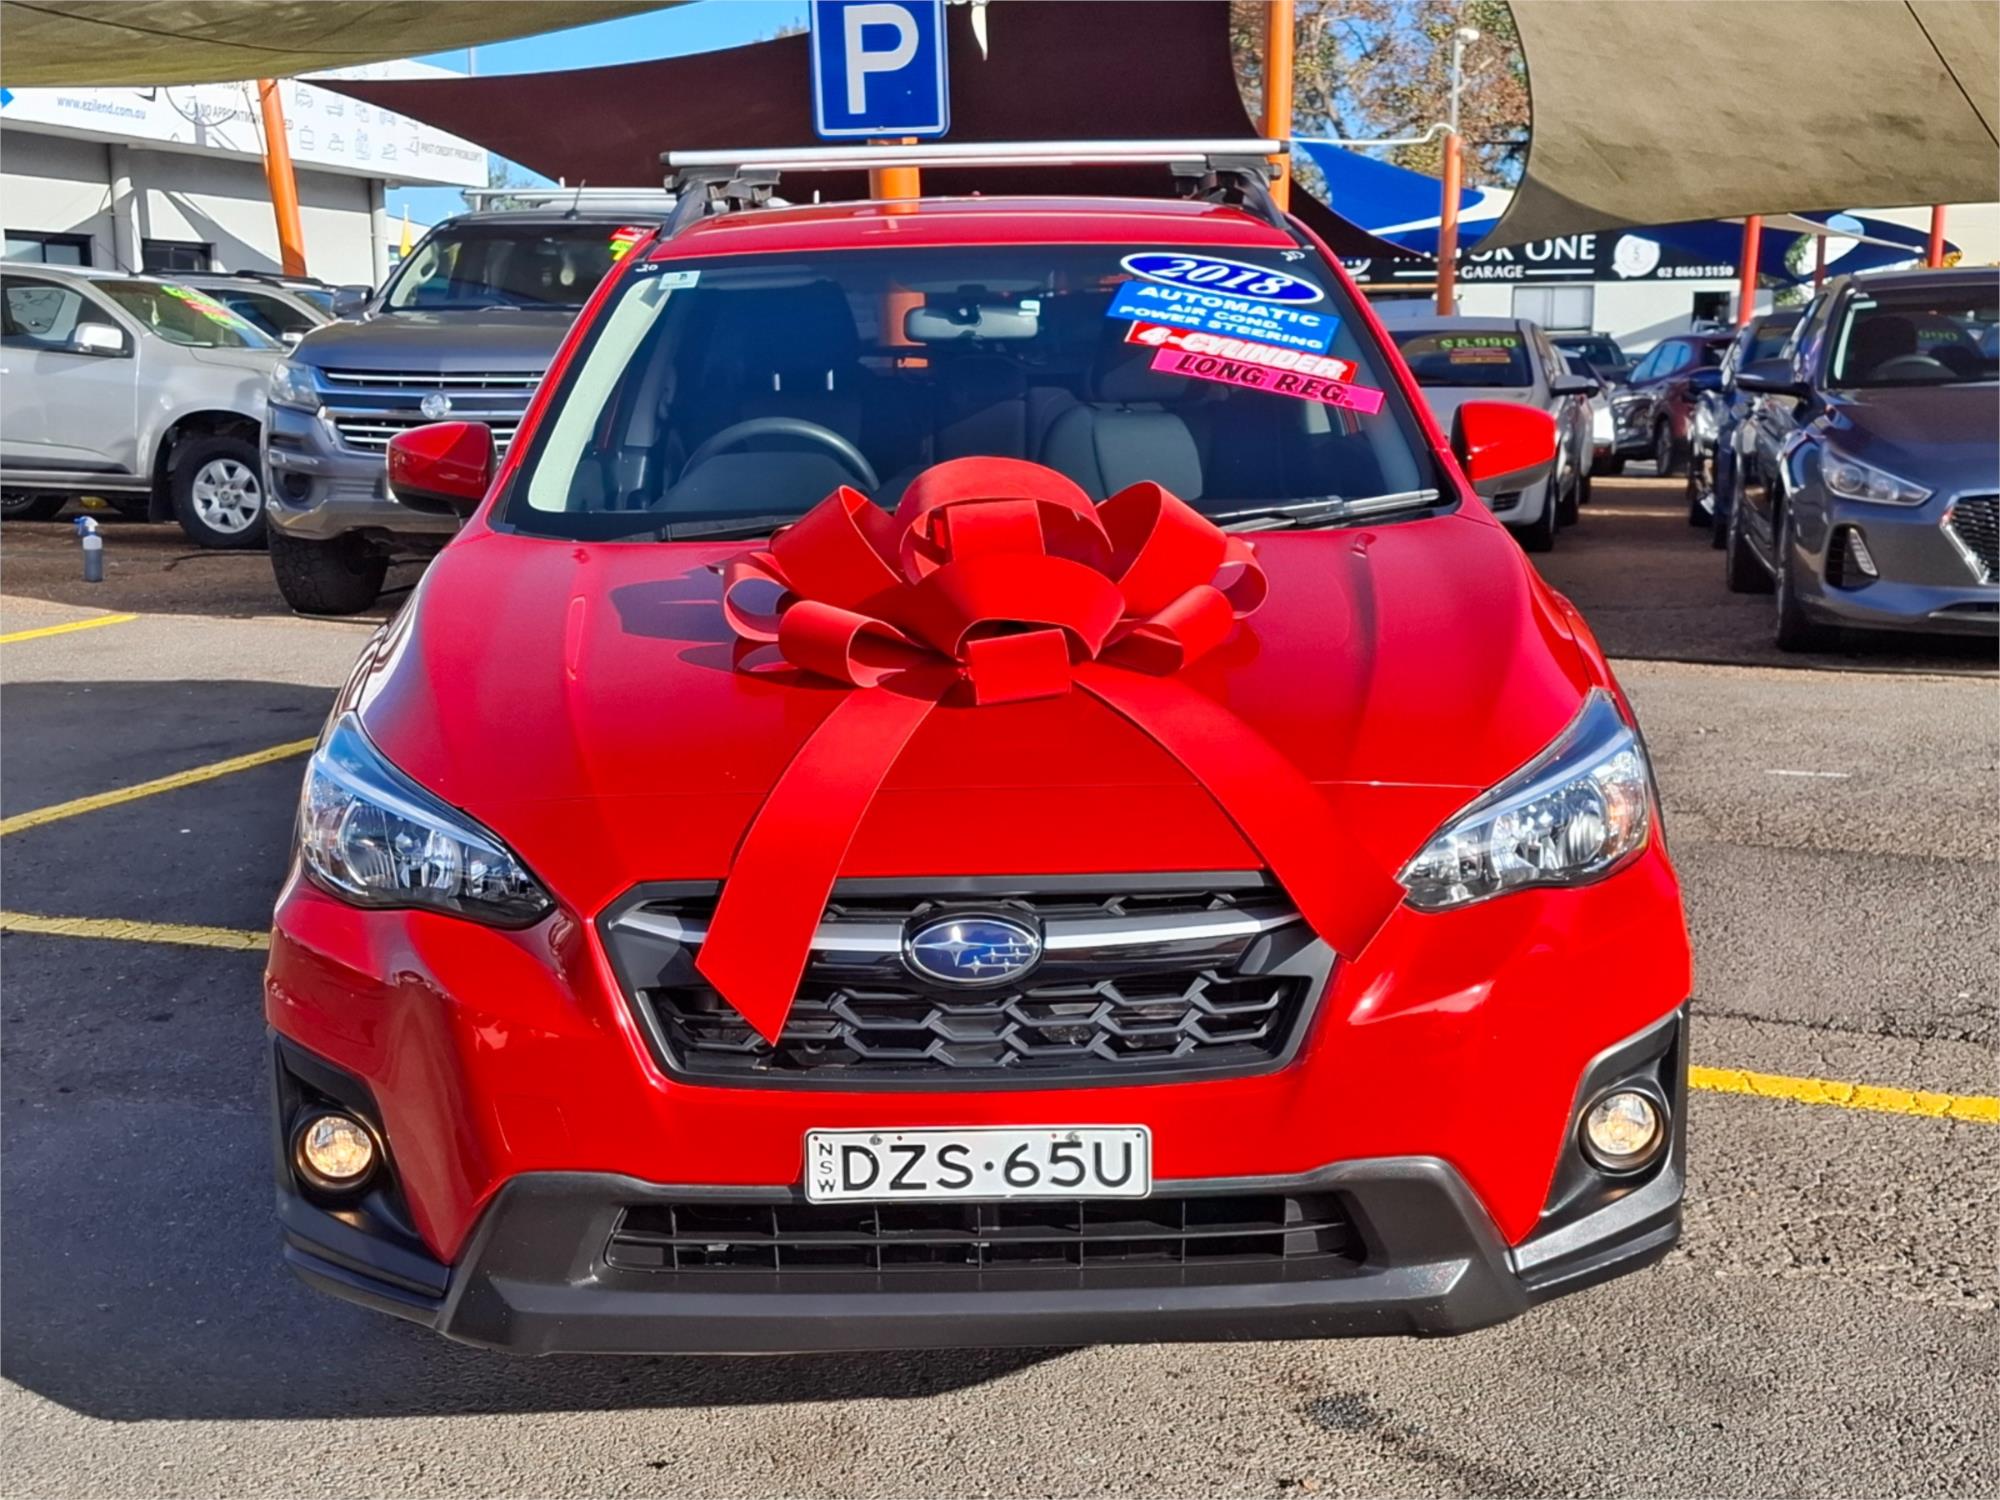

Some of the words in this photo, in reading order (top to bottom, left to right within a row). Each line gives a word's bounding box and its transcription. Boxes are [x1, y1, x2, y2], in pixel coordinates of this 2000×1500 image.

[843, 3, 919, 114] P
[57, 96, 146, 119] www.ezilend.com.au
[1525, 234, 1596, 261] ONE
[1151, 259, 1293, 295] 2018
[1461, 265, 1524, 278] GARAGE
[1138, 287, 1320, 327] AUTOMATIC
[1167, 304, 1207, 317] AIR
[1213, 310, 1283, 331] COND.
[1119, 306, 1200, 326] POWER
[1207, 320, 1323, 349] STEERING
[1174, 354, 1265, 384] LONG
[1273, 374, 1354, 406] REG.
